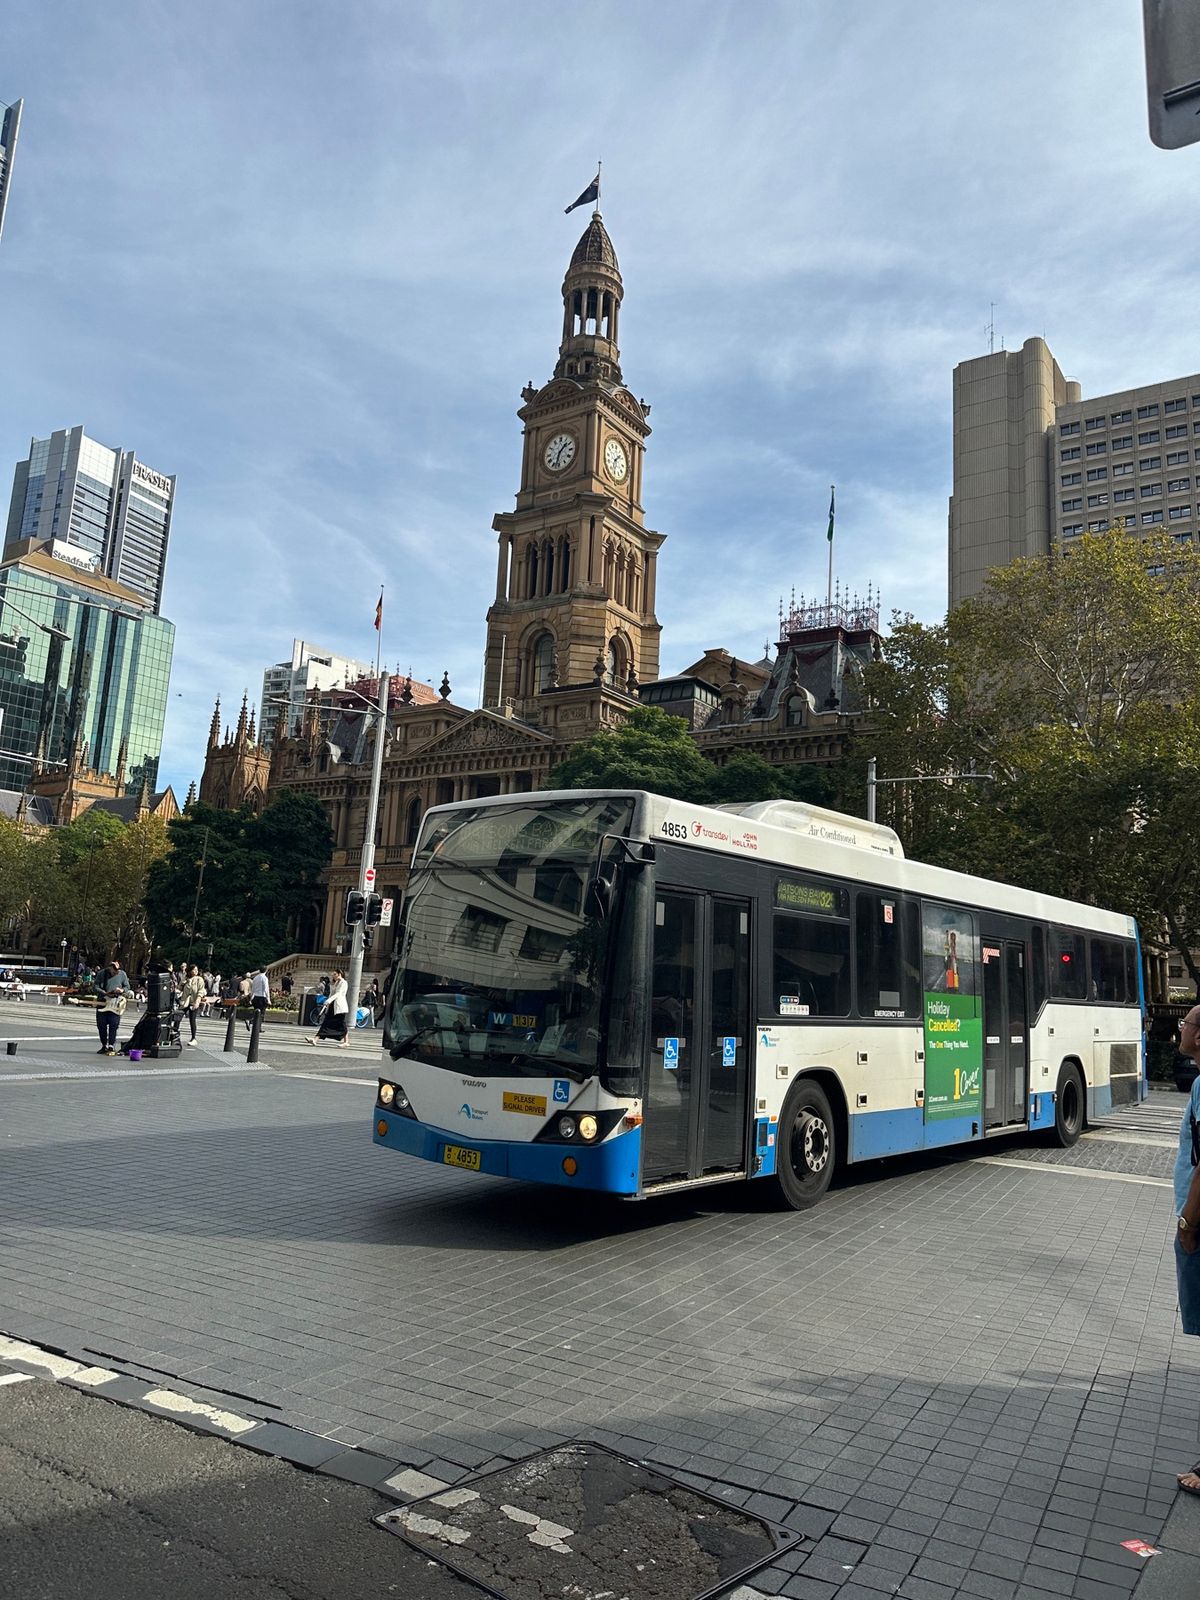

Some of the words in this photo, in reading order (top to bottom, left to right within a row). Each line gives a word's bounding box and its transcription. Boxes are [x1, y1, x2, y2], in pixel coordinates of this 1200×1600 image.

[133, 463, 170, 492] FRASER
[53, 550, 91, 570] Steadfast
[662, 821, 687, 839] 4853
[702, 828, 728, 841] transdev
[742, 832, 757, 841] JOHN
[808, 824, 819, 837] Air
[820, 826, 857, 845] Conditioned
[732, 839, 758, 850] HOLLAND
[820, 890, 833, 908] 32
[874, 1009, 897, 1018] EMERGENCY
[897, 1010, 905, 1018] EXIT
[927, 1001, 950, 1018] Holiday
[493, 1012, 506, 1025] W
[514, 1013, 535, 1028] 137
[928, 1018, 961, 1032] Cancelled?
[462, 1079, 487, 1089] VOLVO
[513, 1095, 536, 1105] PLEASE
[503, 1102, 524, 1112] SIGNAL
[524, 1105, 546, 1116] DRIVER
[456, 1149, 478, 1165] 4853
